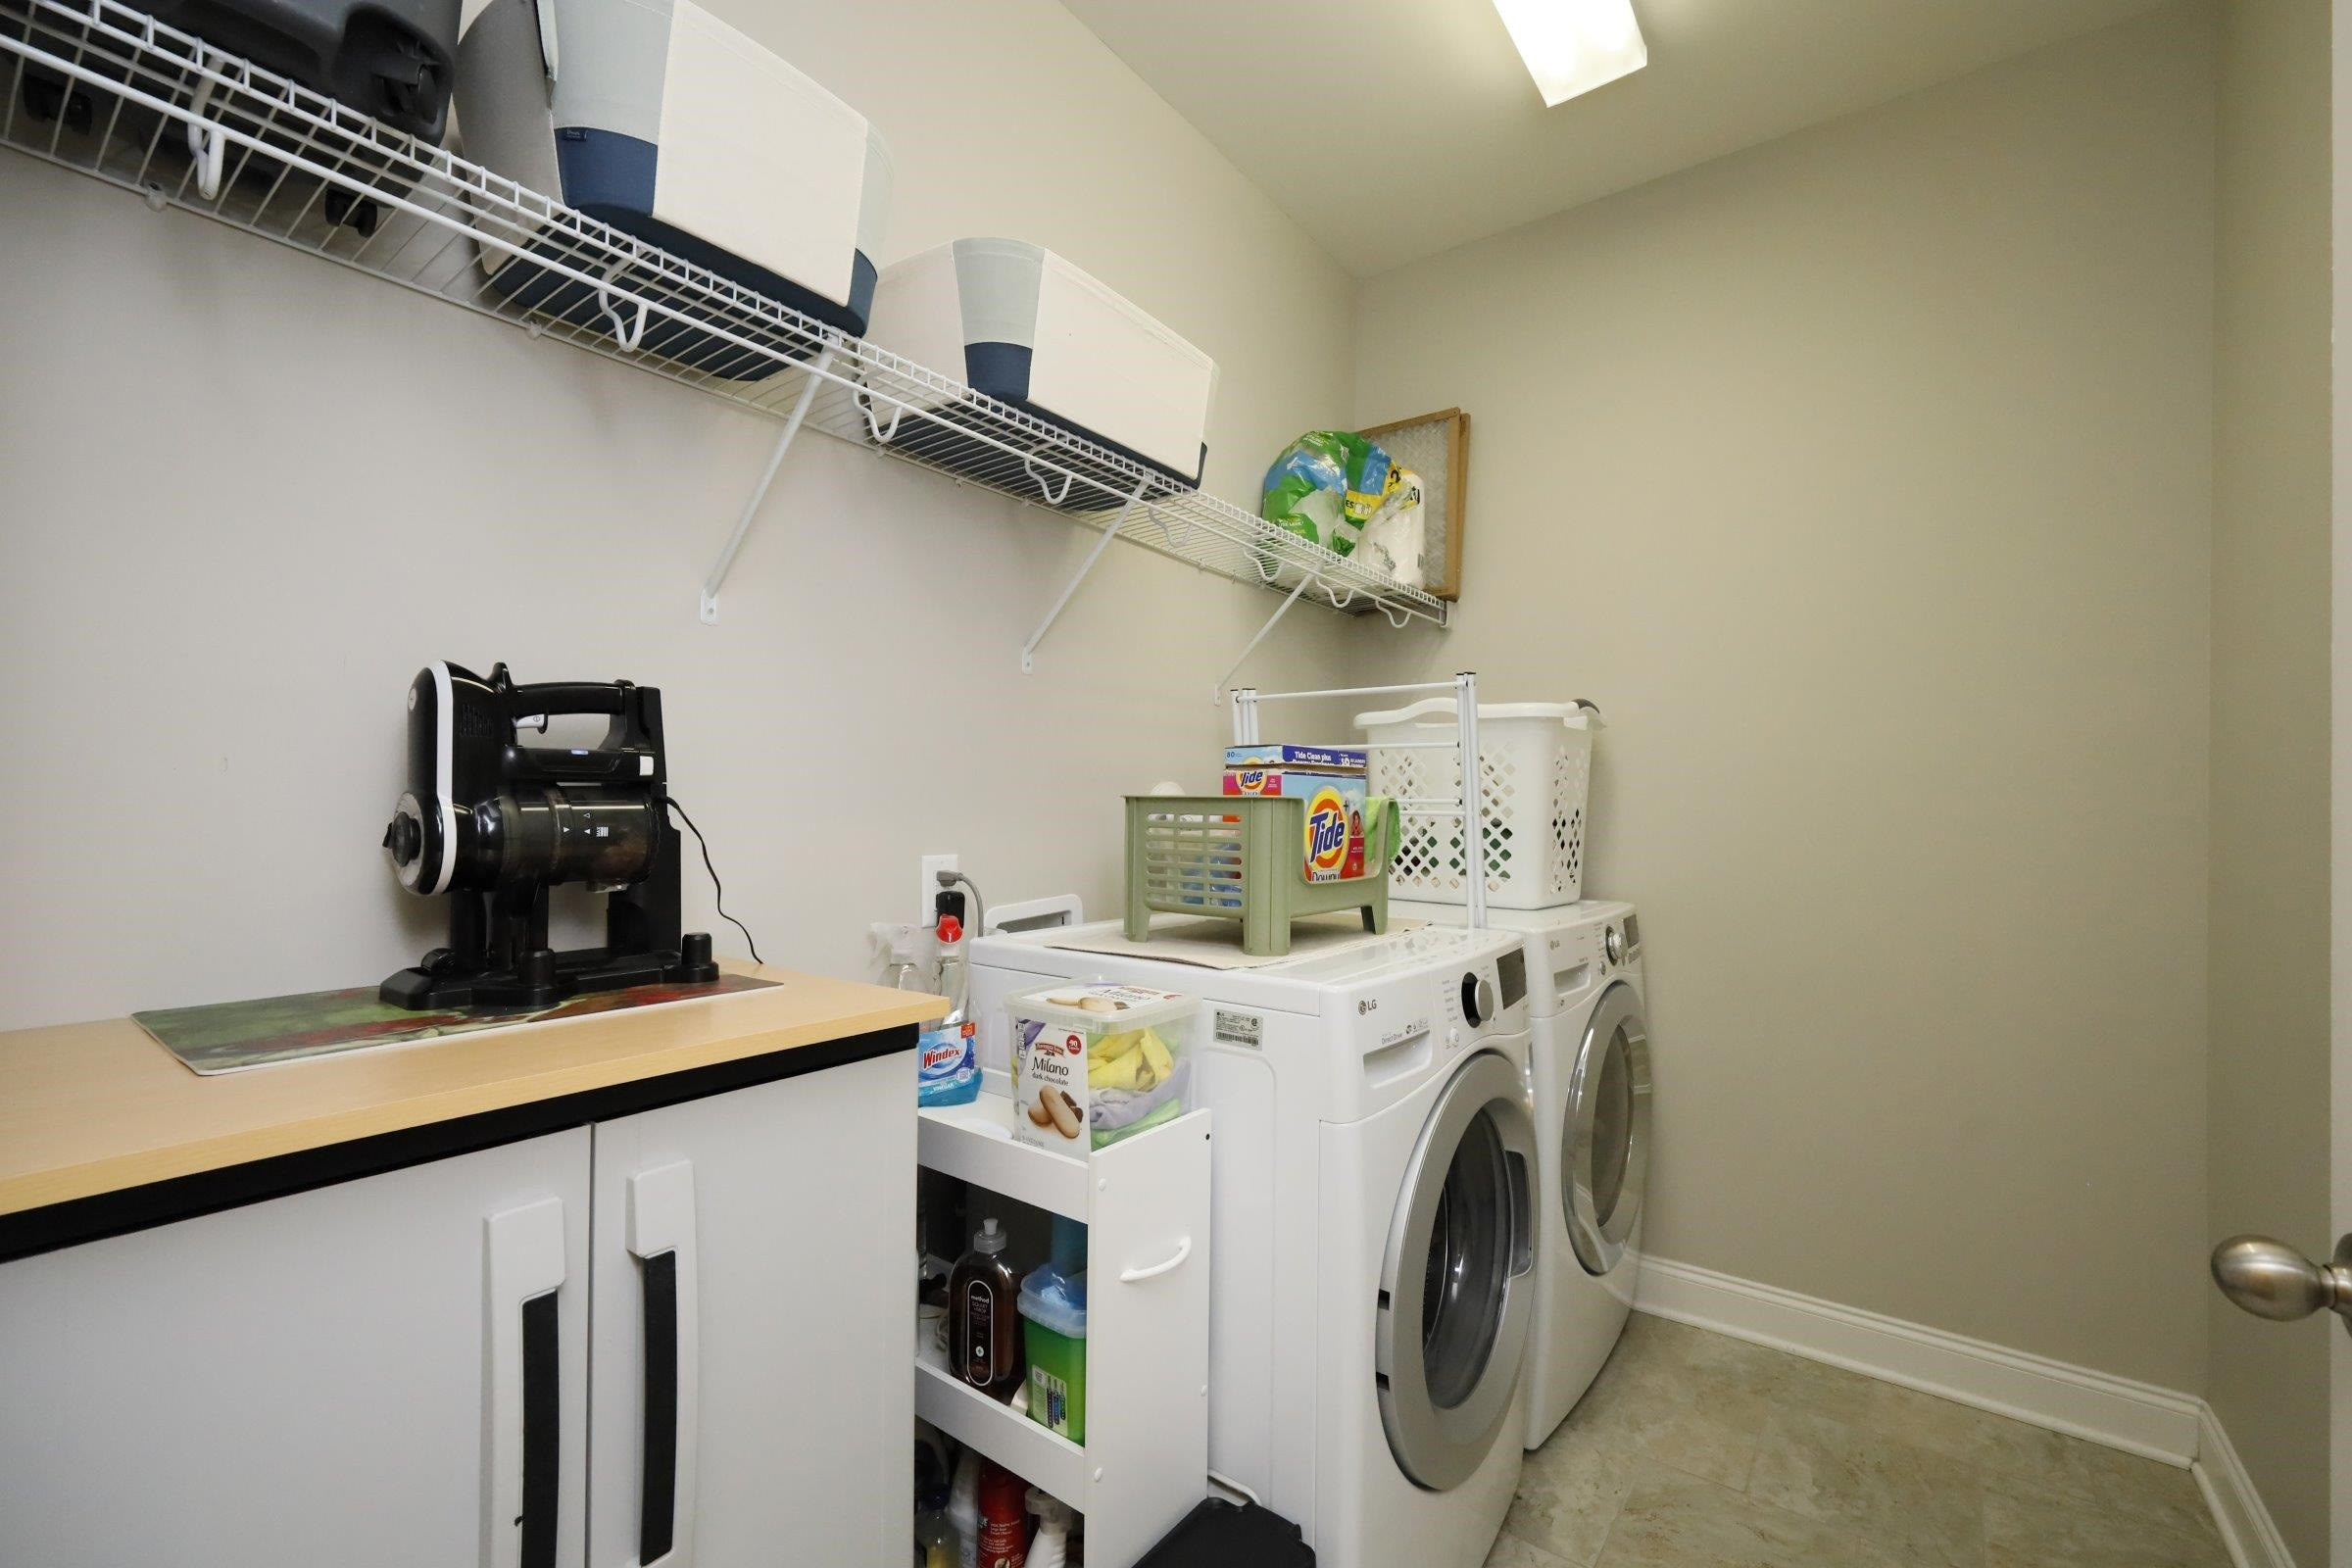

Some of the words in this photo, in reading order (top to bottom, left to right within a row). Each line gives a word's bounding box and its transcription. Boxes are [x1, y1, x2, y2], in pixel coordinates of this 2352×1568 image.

[1295, 751, 1306, 760] Tide
[1306, 752, 1321, 760] Clean
[1321, 754, 1332, 762] plus
[1309, 811, 1346, 863] Tide
[923, 1048, 960, 1071] Windex
[1031, 1055, 1069, 1076] Milano
[1032, 1072, 1043, 1081] dark
[1044, 1075, 1069, 1087] chocolate
[970, 1295, 990, 1303] method
